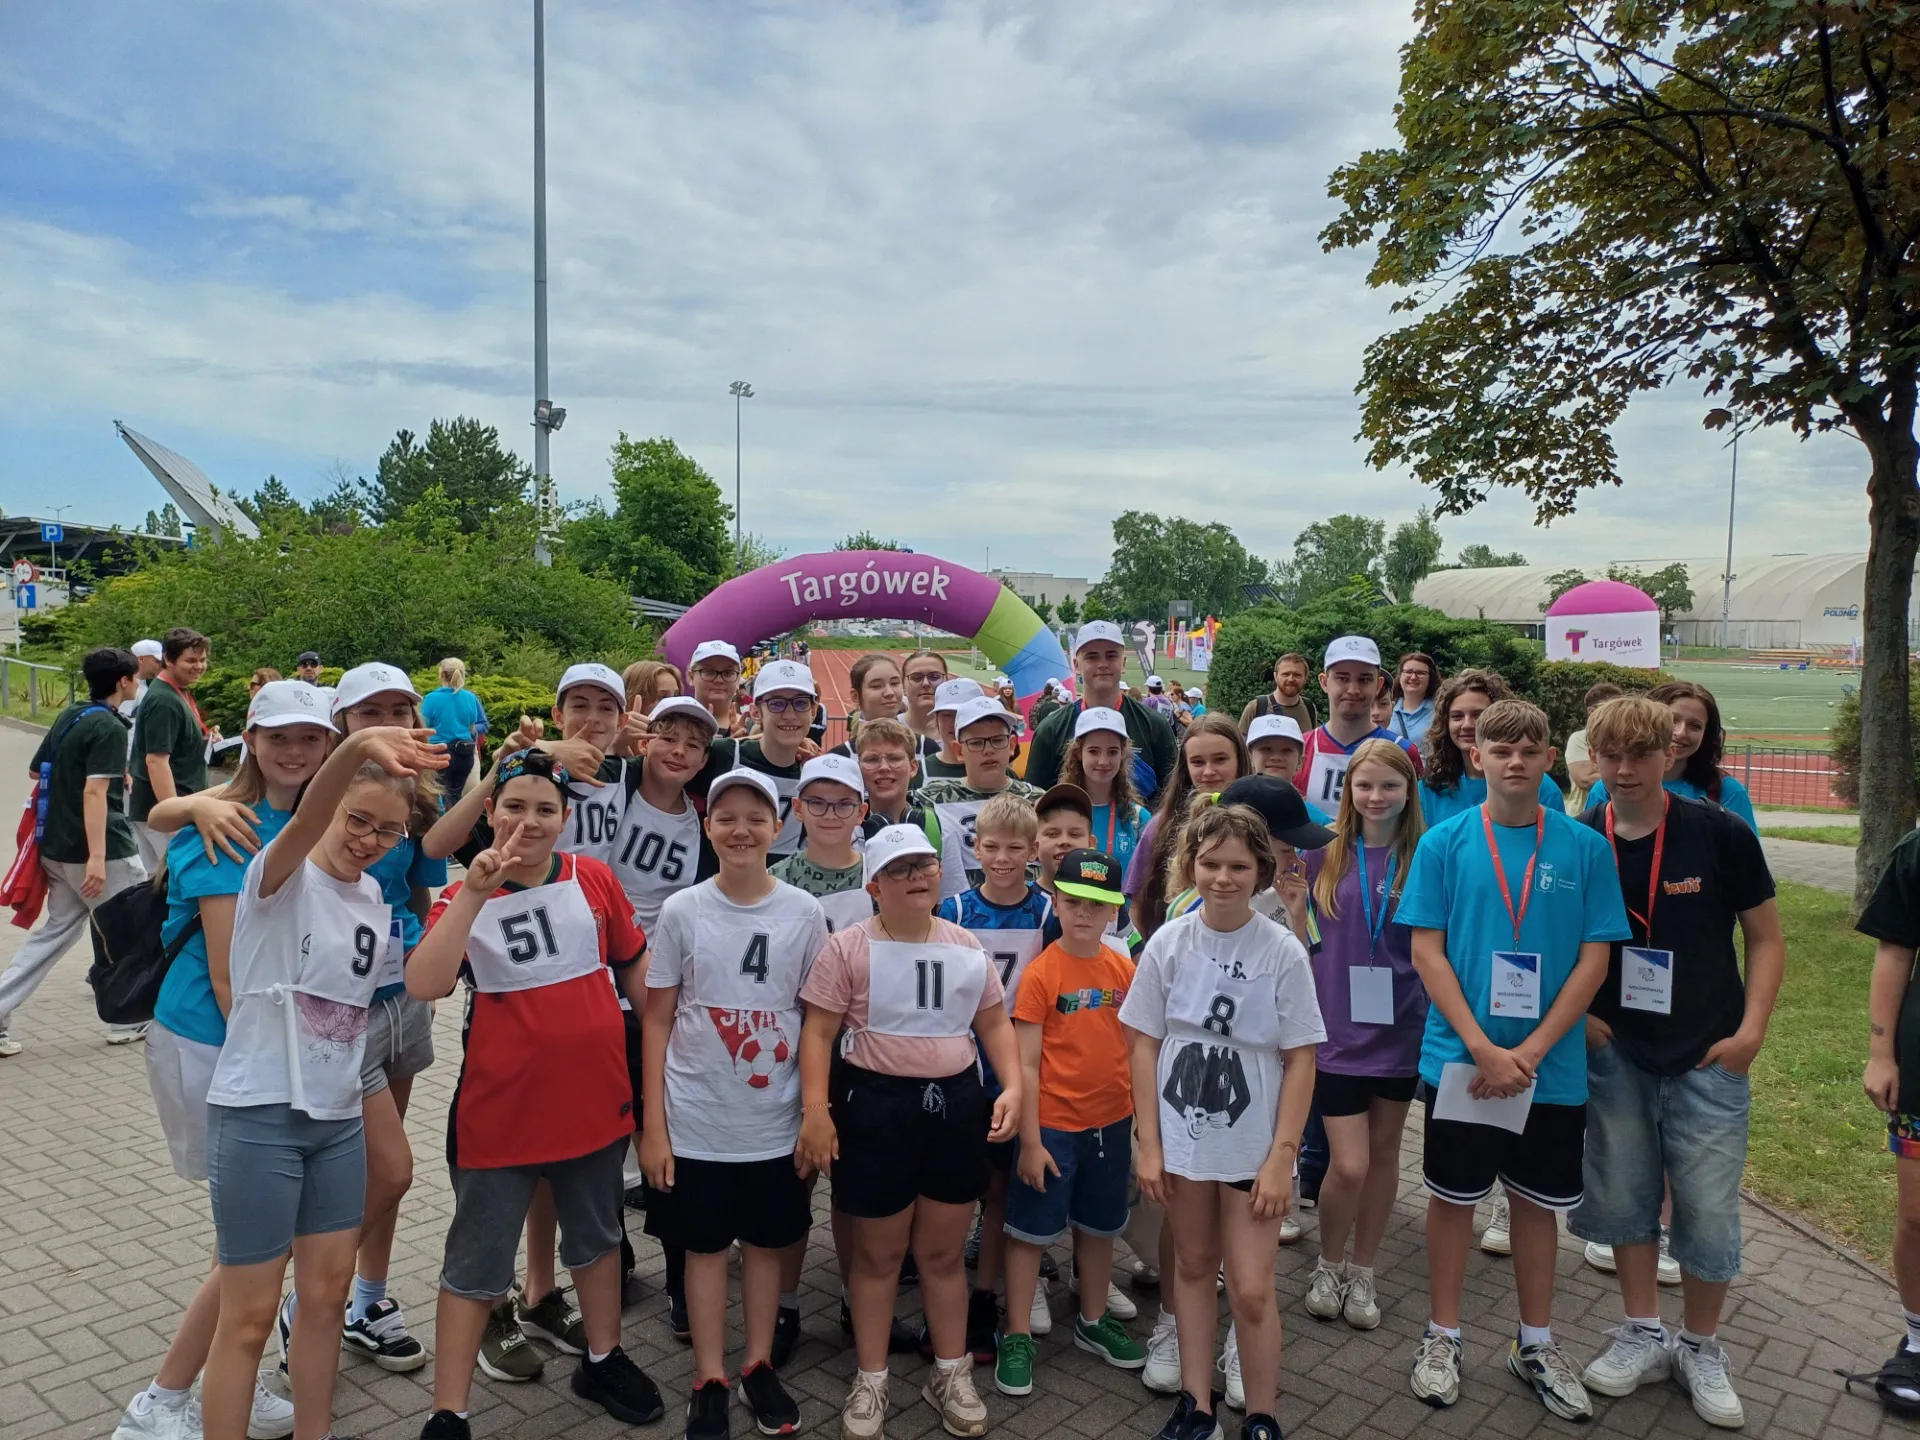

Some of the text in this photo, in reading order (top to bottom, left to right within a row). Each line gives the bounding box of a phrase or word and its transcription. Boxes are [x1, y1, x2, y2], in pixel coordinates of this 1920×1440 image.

[45, 525, 58, 540] P
[780, 560, 951, 607] Targówek
[1823, 609, 1859, 617] POLONEZ
[1592, 636, 1642, 651] Targówek
[573, 799, 618, 846] 106
[617, 823, 689, 883] 105
[350, 922, 377, 980] 9
[497, 905, 560, 965] 51
[739, 932, 769, 984] 4
[915, 959, 945, 1010] 11
[993, 951, 1019, 991] 7
[1202, 992, 1237, 1038] 8
